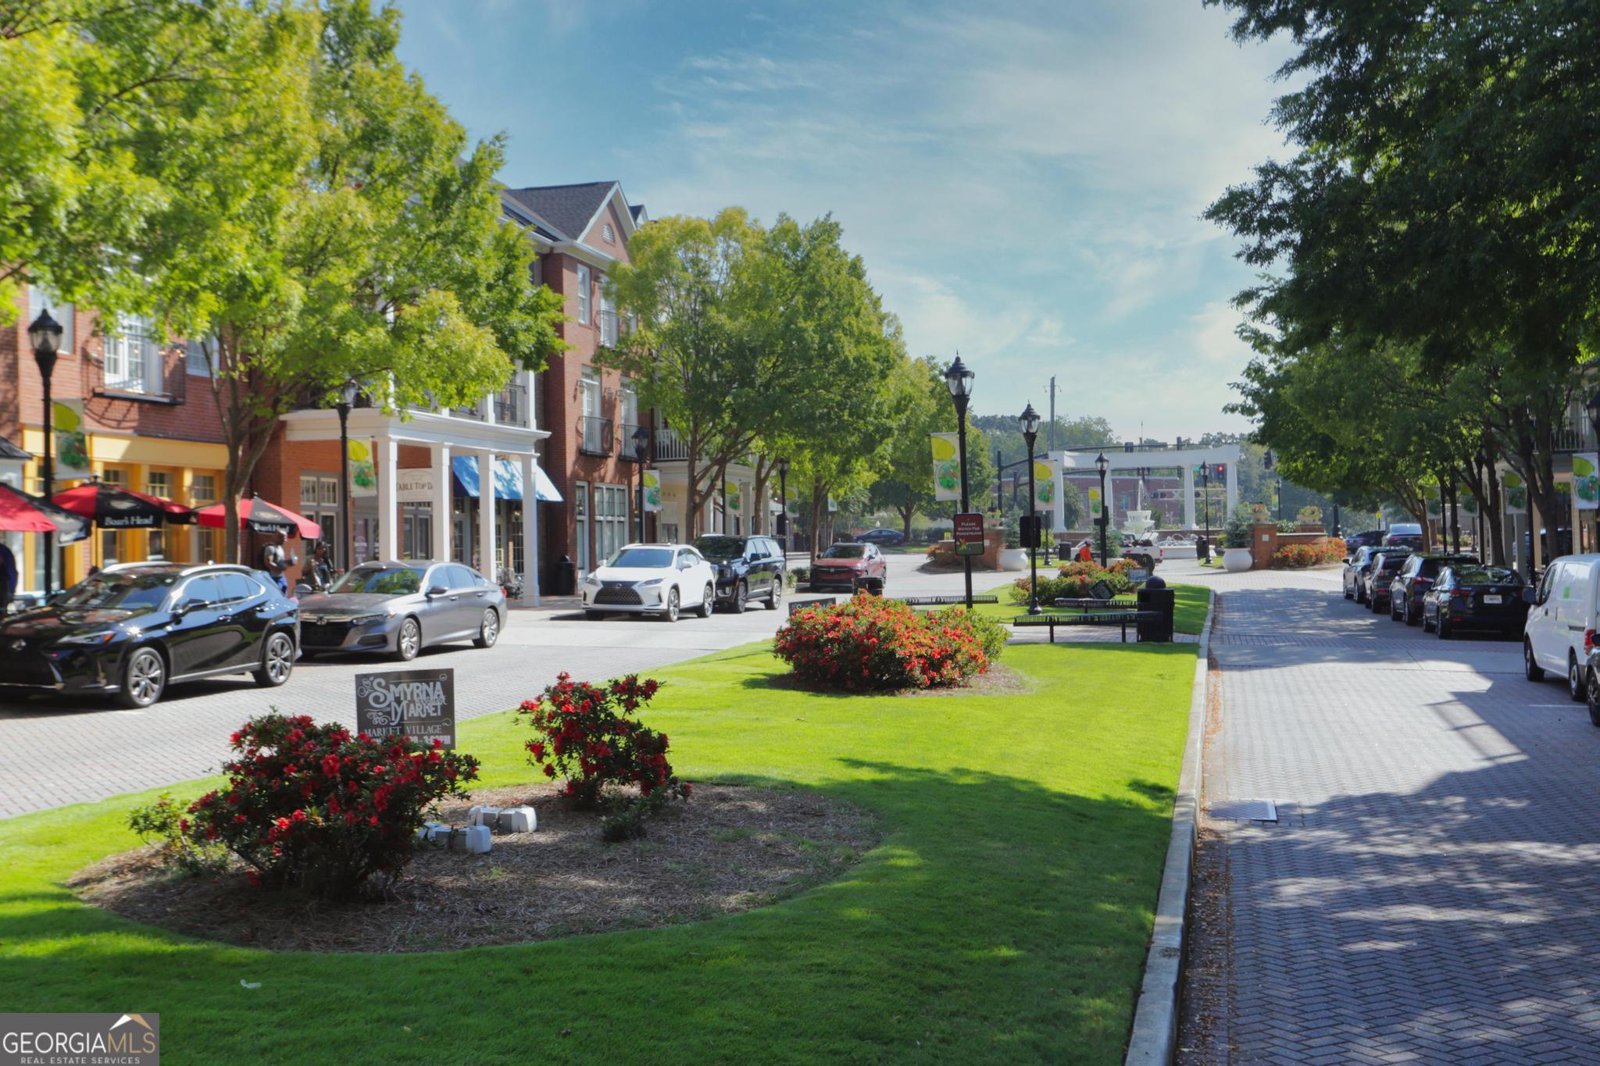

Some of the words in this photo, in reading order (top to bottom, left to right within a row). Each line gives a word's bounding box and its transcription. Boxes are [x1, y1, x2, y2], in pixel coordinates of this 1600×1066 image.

[130, 515, 154, 525] Head
[368, 677, 445, 708] SMYRNA
[390, 701, 442, 725] MARKET
[406, 724, 443, 735] VILLAGE
